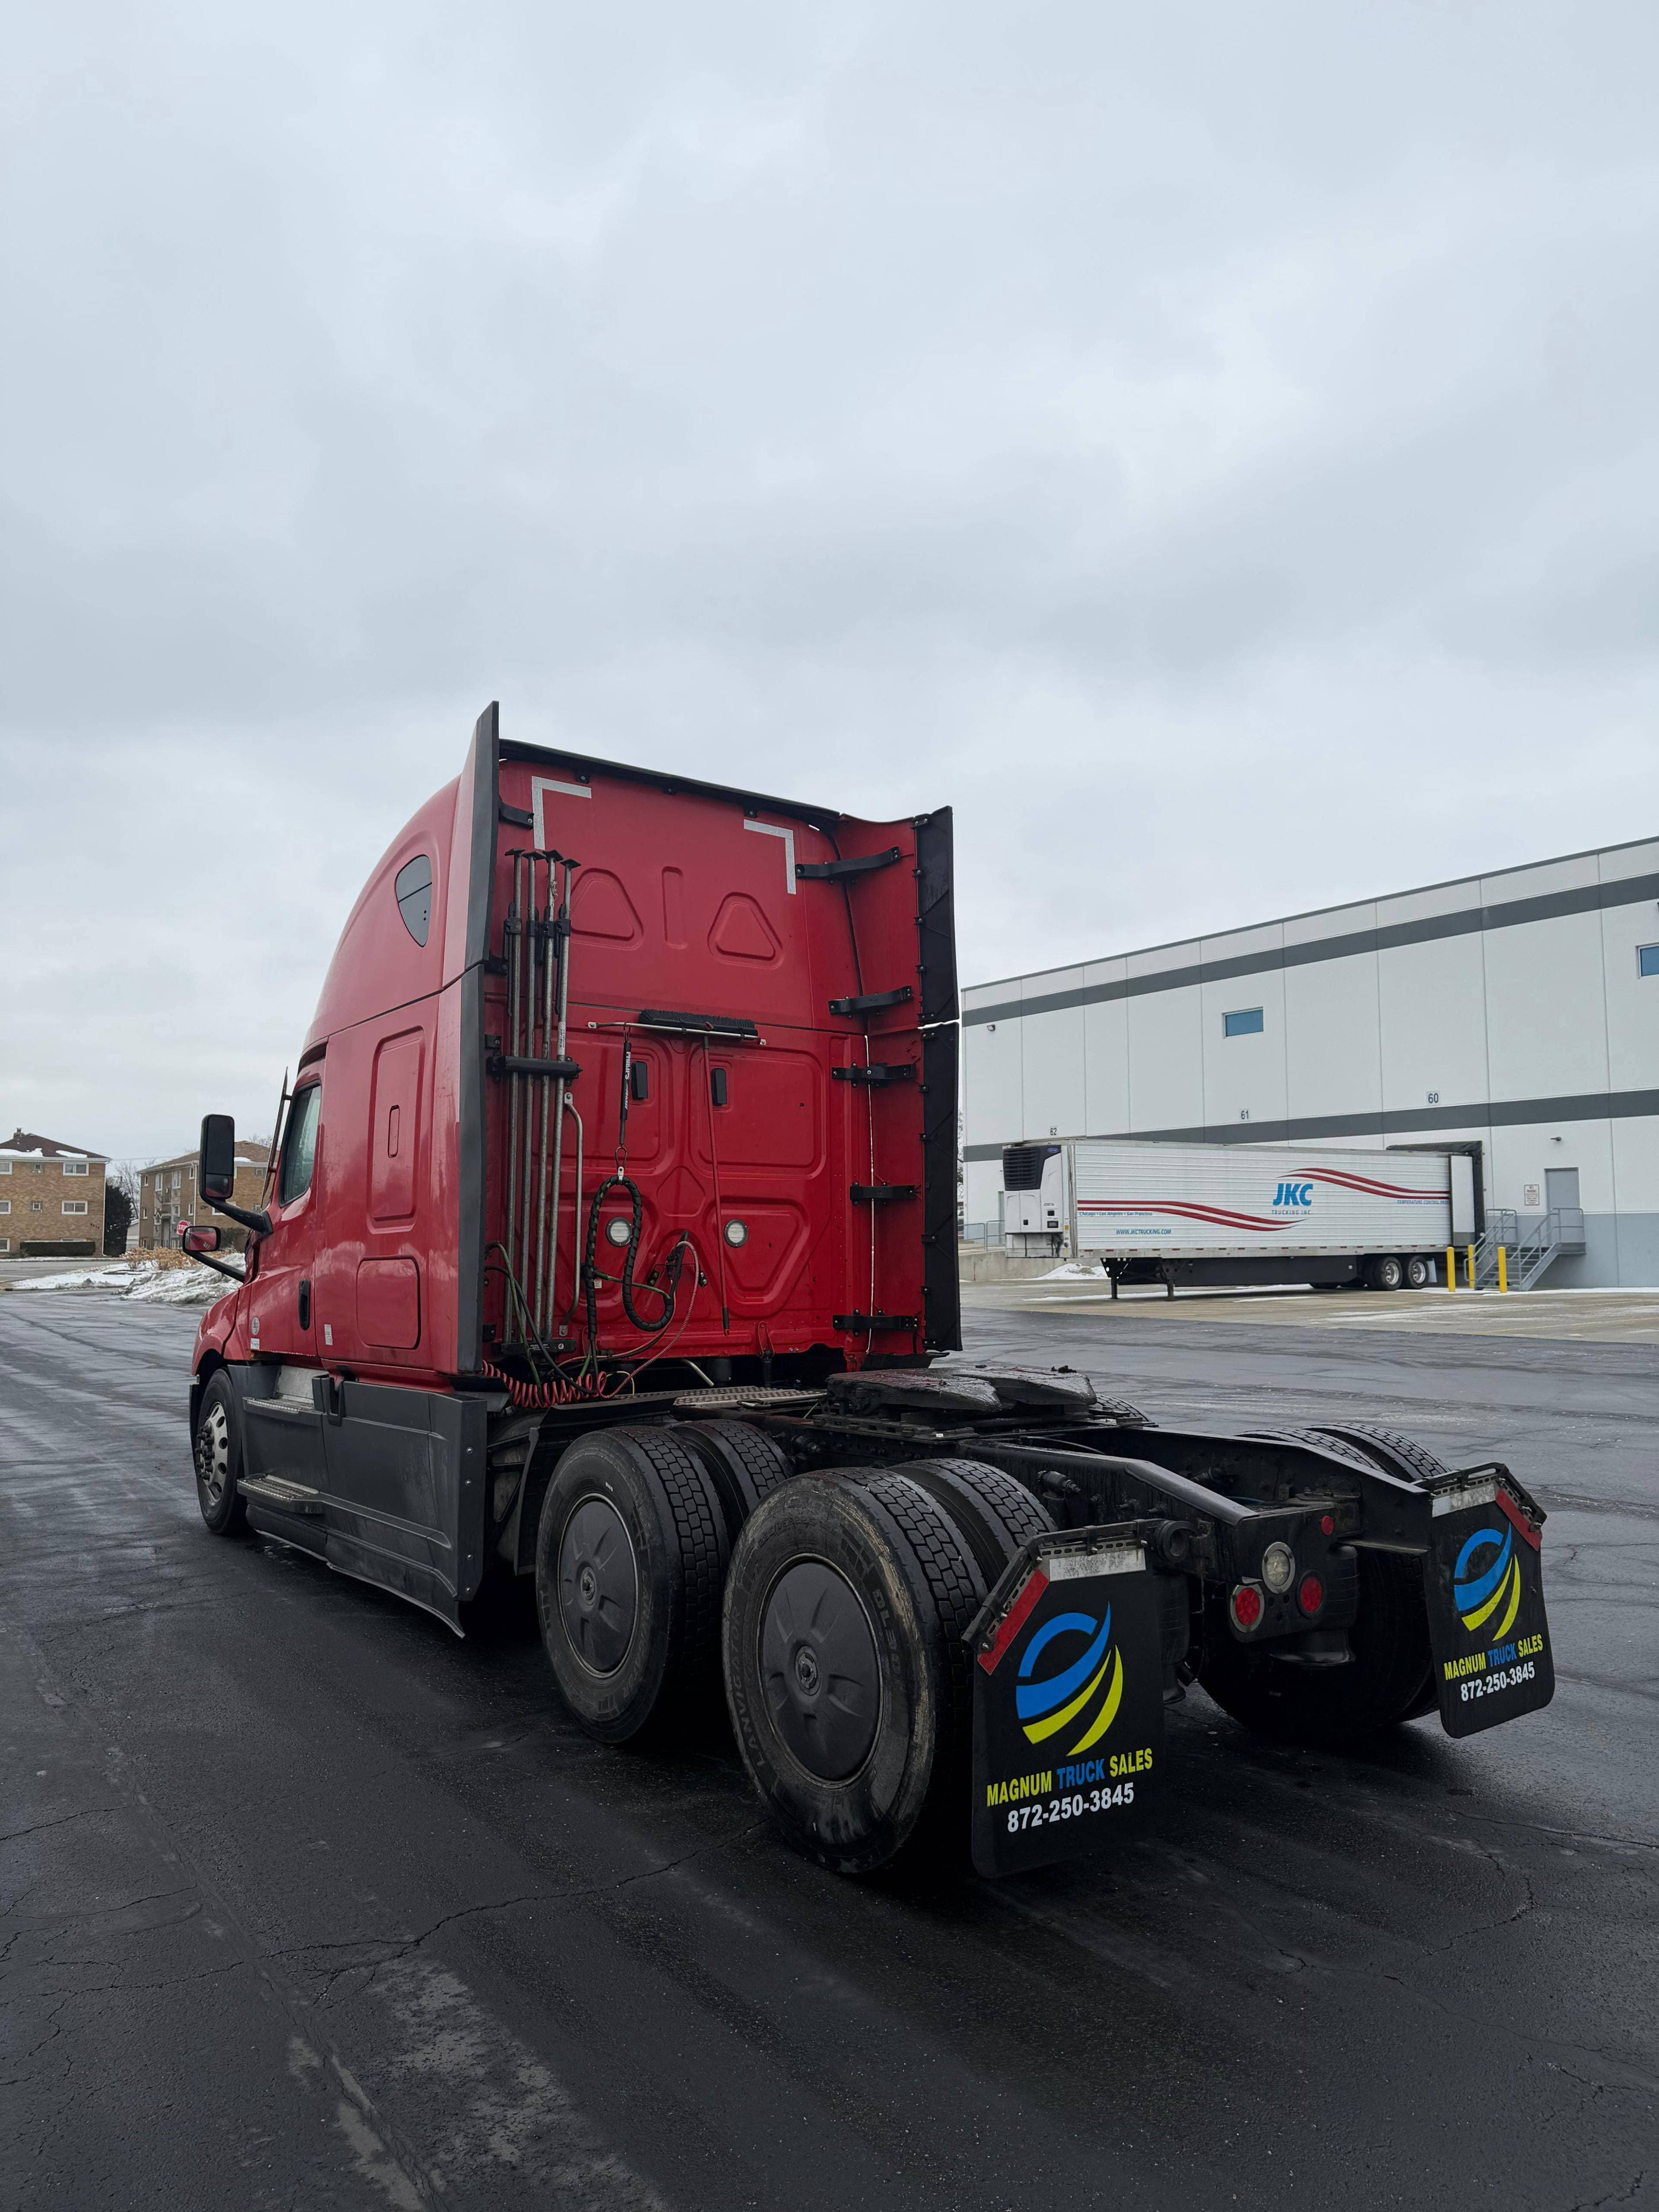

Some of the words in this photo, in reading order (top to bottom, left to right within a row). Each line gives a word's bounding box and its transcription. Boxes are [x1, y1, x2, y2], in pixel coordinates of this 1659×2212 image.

[1428, 1093, 1439, 1103] 60
[1241, 1110, 1248, 1120] 61
[1050, 1127, 1057, 1136] 62
[1273, 1183, 1313, 1206] JKC
[1444, 1652, 1486, 1680] MAGNUM
[1487, 1643, 1517, 1667] TRUCK
[1518, 1634, 1543, 1658] SALES
[1461, 1661, 1535, 1701] 872-250-3845
[987, 1770, 1052, 1807] MAGNUM
[1057, 1759, 1105, 1789] TRUCK
[1110, 1748, 1153, 1777] SALES
[1007, 1782, 1134, 1832] 872-250-3845
